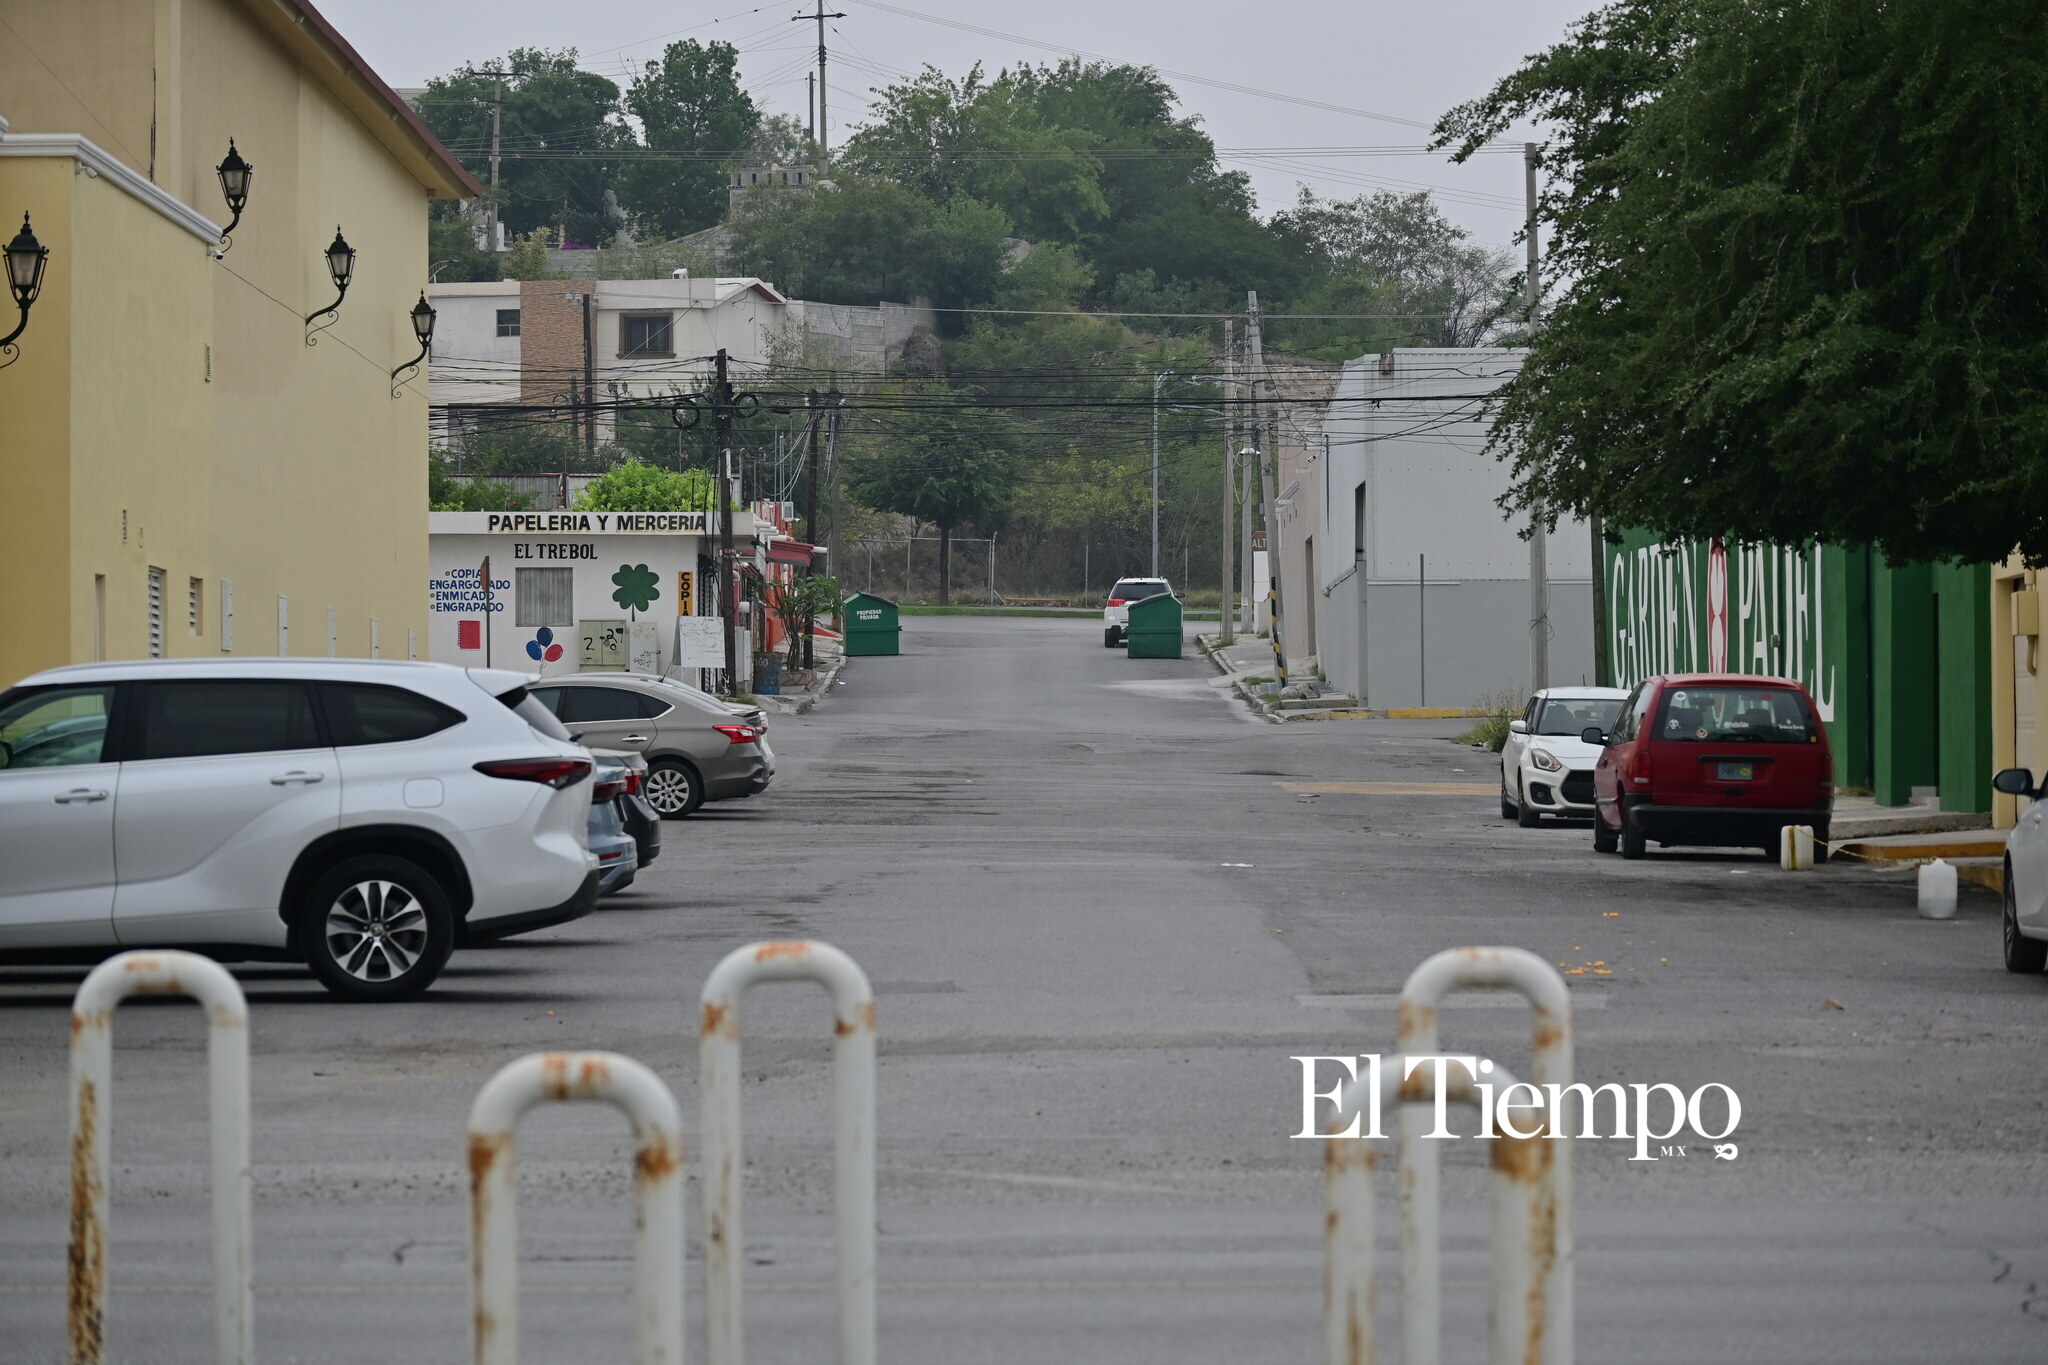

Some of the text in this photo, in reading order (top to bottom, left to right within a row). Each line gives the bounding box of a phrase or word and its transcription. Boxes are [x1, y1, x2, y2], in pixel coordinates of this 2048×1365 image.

[488, 514, 705, 532] PAPELERIA Y MERCERIA
[1252, 539, 1267, 548] ALT
[514, 543, 598, 560] EL TREBOL
[429, 580, 511, 590] ENGARGOADO
[436, 591, 495, 601] ENMICADO
[436, 602, 504, 612] ENGRAPADO
[1612, 537, 1697, 690] GARDEN
